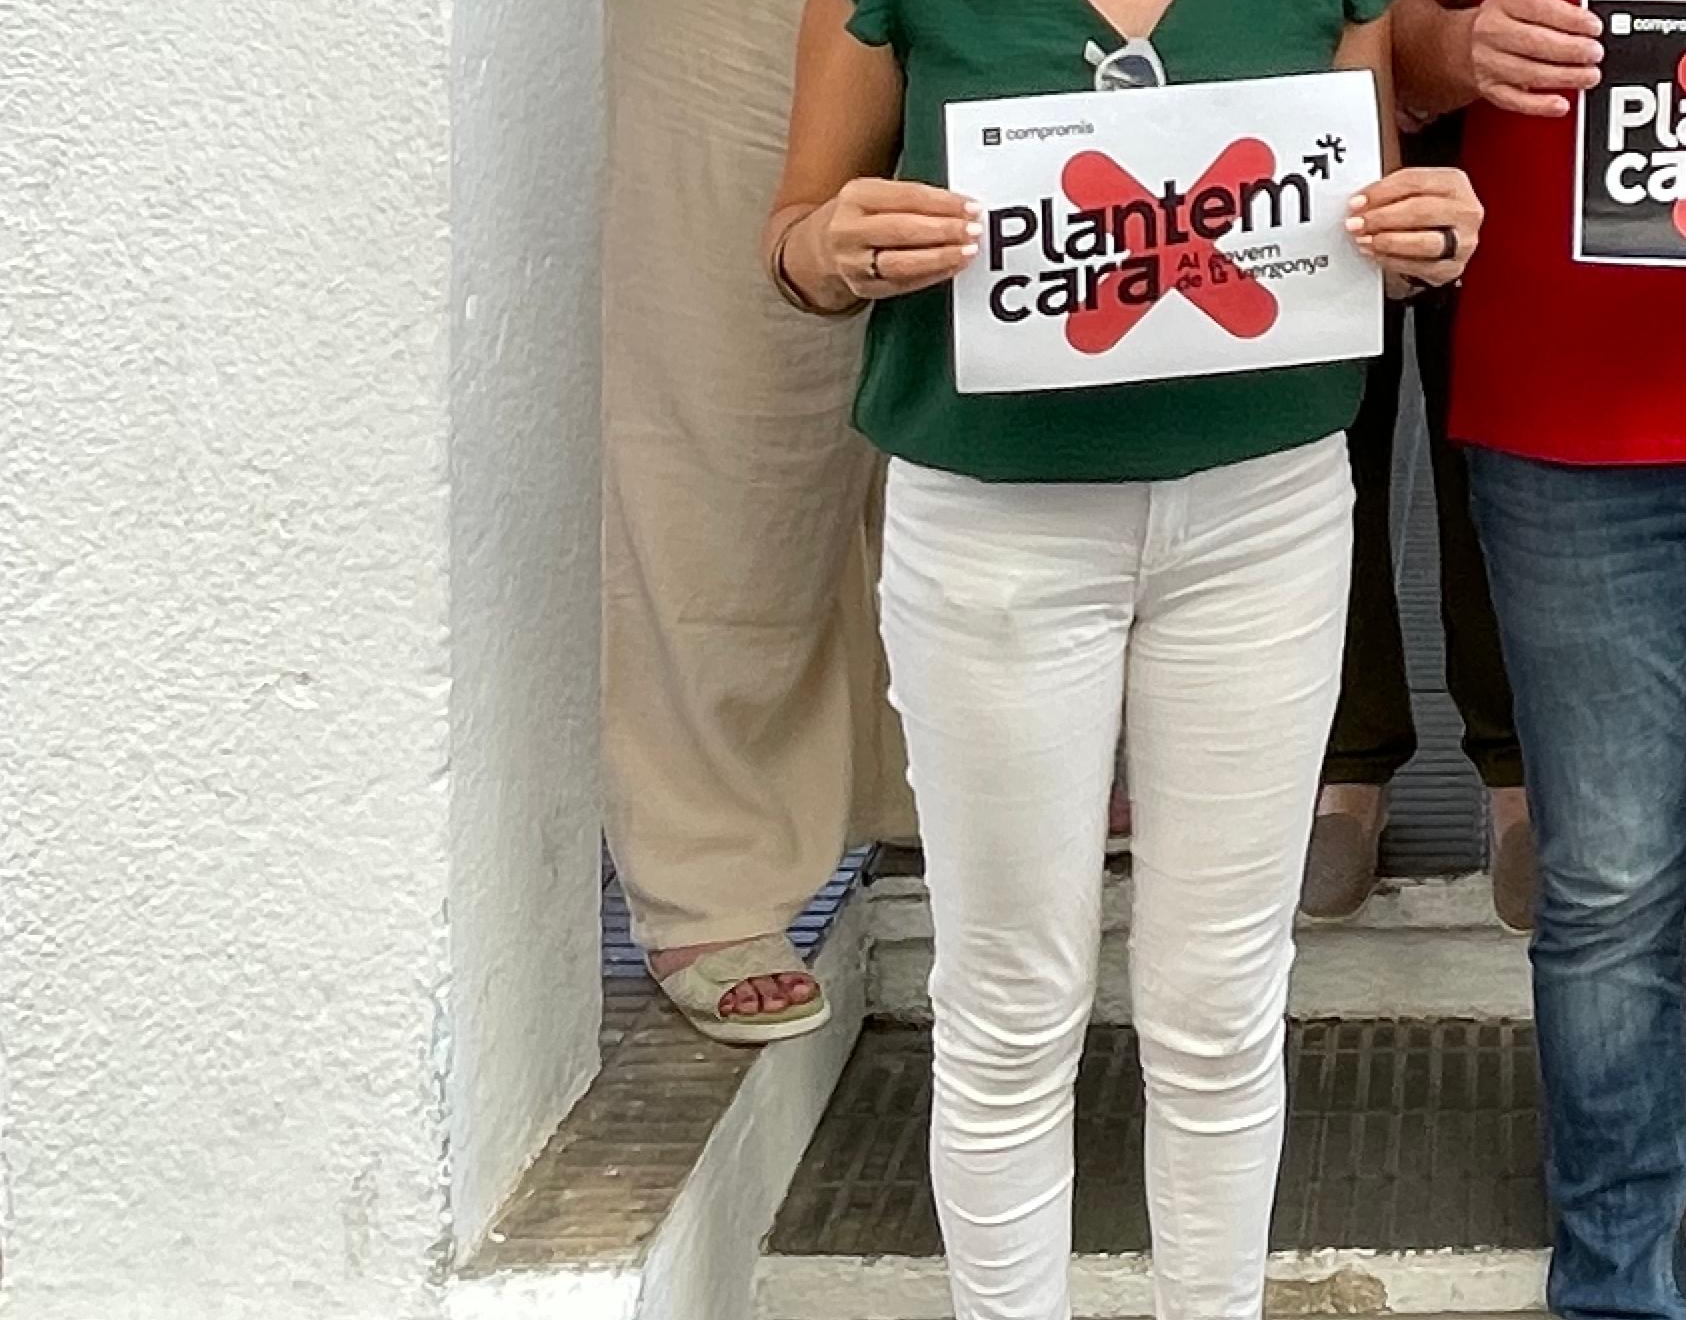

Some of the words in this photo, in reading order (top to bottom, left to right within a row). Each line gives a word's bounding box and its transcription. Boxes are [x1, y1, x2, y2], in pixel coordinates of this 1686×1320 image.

[989, 172, 1310, 271] Plantem
[989, 256, 1160, 323] cara
[1177, 252, 1200, 272] Al
